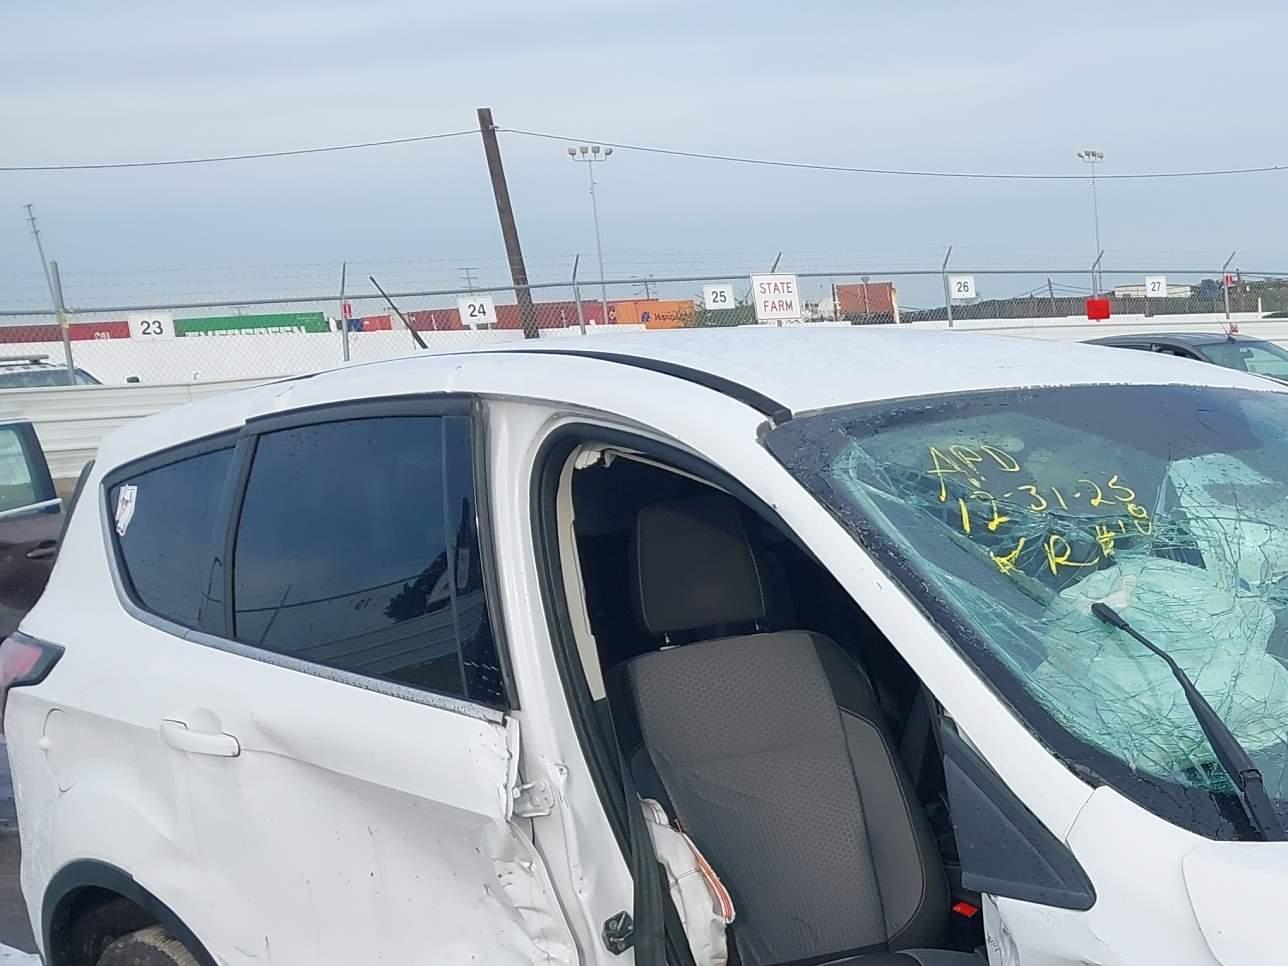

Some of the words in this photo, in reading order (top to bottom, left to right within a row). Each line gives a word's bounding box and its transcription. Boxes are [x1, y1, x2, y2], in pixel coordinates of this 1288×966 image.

[759, 281, 793, 295] STATE
[956, 281, 969, 293] 26
[1150, 281, 1161, 292] 27
[711, 291, 727, 303] 25
[467, 303, 487, 318] 24
[763, 300, 794, 313] FARM
[140, 320, 164, 336] 23
[926, 445, 1021, 502] APD
